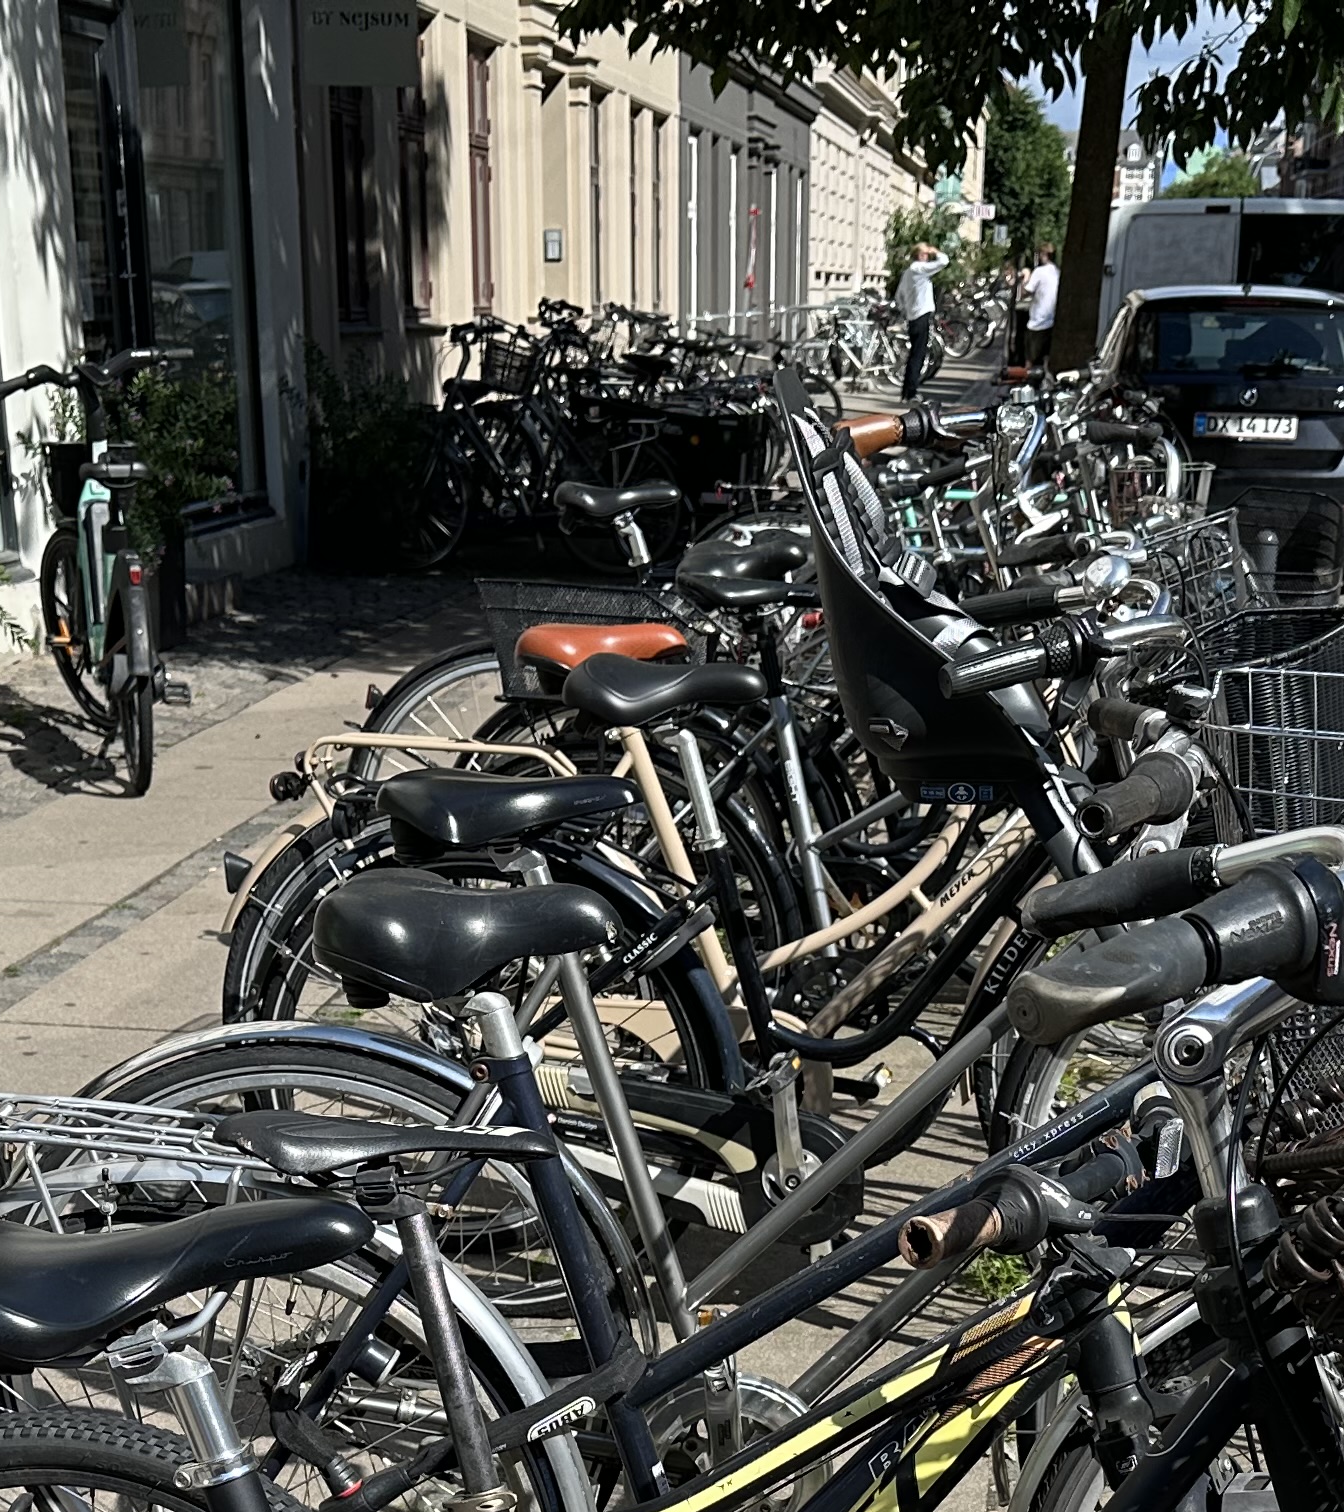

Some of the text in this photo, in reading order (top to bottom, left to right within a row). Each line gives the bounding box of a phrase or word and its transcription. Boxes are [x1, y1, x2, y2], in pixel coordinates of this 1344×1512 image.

[1207, 416, 1292, 434] DX 14 173
[939, 868, 977, 907] MEYER
[623, 932, 658, 964] CLASSIC
